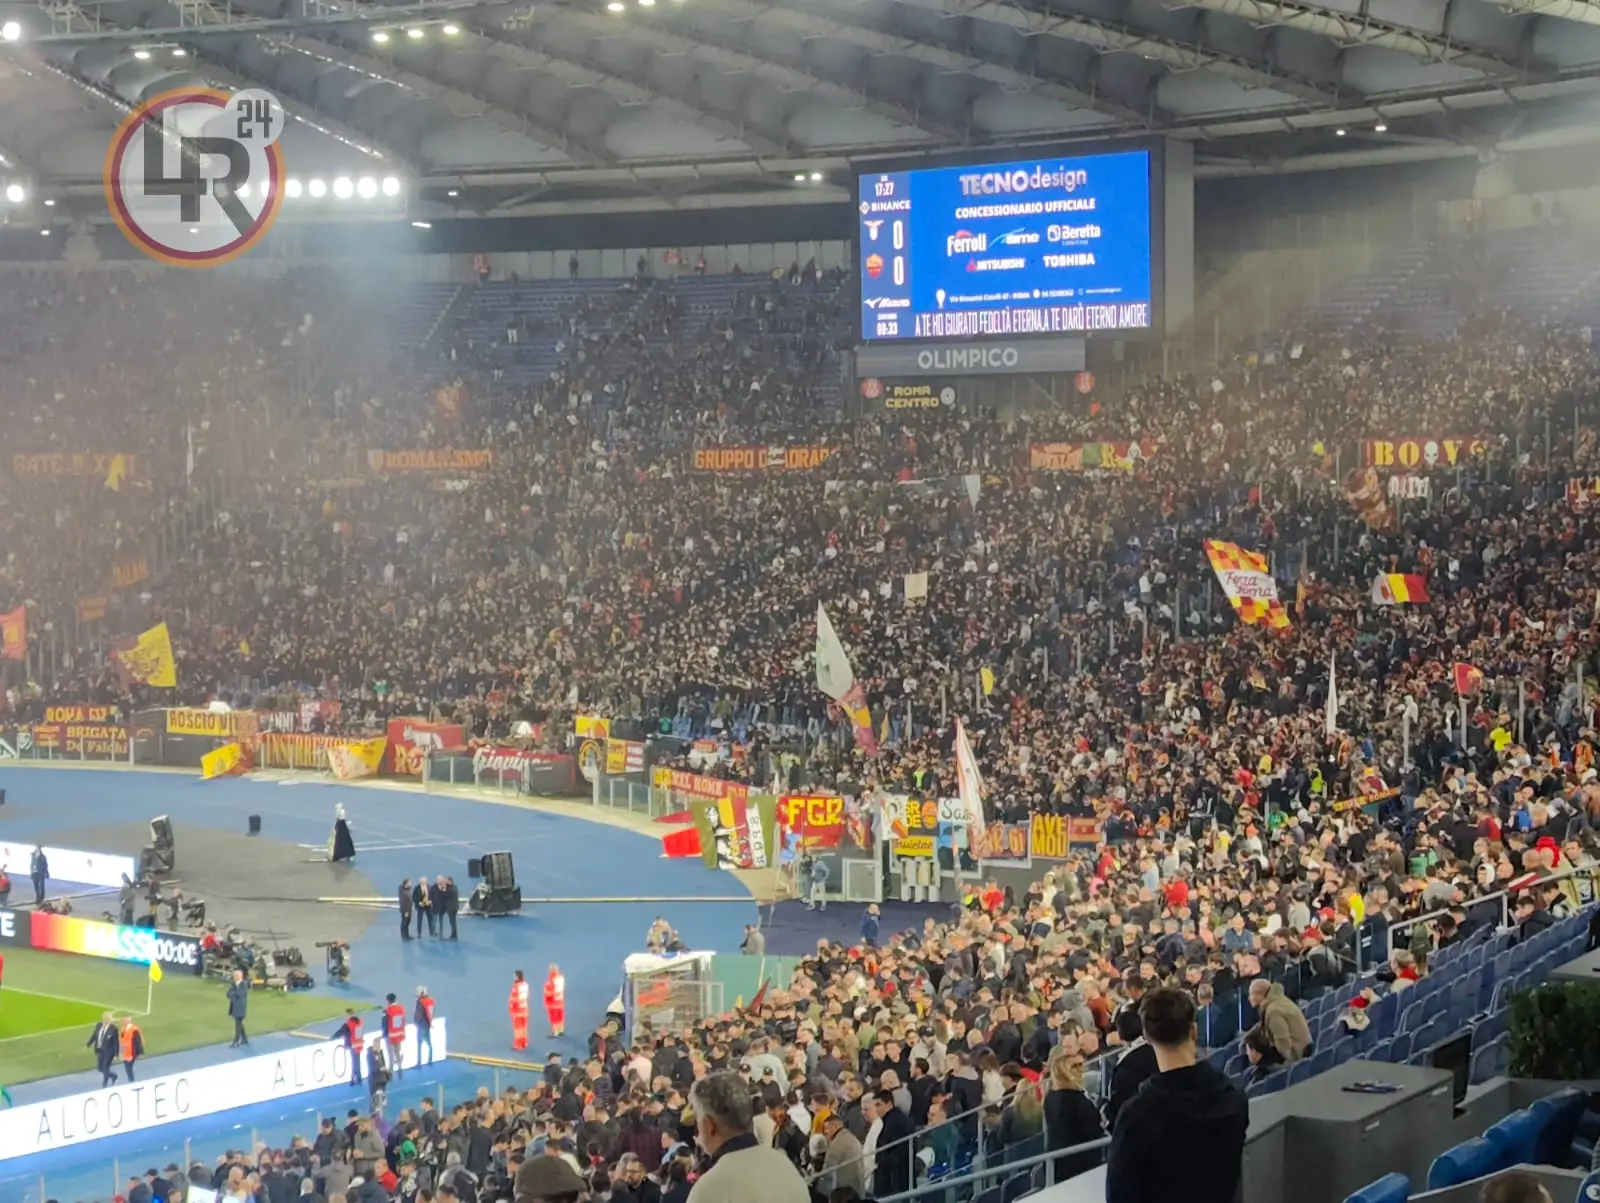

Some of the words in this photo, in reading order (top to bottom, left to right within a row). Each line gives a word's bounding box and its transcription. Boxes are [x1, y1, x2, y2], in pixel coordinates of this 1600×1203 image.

[871, 200, 911, 212] BINANCE
[955, 203, 1043, 219] CONCESSIONARIO
[1045, 198, 1096, 212] UFFICIALE
[1043, 253, 1096, 267] TOSHIBA
[914, 314, 921, 337] A
[922, 313, 931, 336] TE
[932, 313, 944, 335] HO
[945, 310, 978, 335] GIURATO
[979, 305, 1012, 334] FEDELTÀ
[1050, 307, 1060, 331] TE
[1086, 305, 1117, 329] ETERNO
[1118, 303, 1148, 328] AMORE
[917, 347, 1018, 370] OLIMPICO
[893, 385, 931, 396] ROMA
[885, 397, 940, 409] CENTRO
[694, 449, 754, 470] GRUPPO
[66, 725, 127, 740] BRIGATA
[1034, 814, 1067, 834] AVE
[37, 1077, 191, 1145] ALCOTEC
